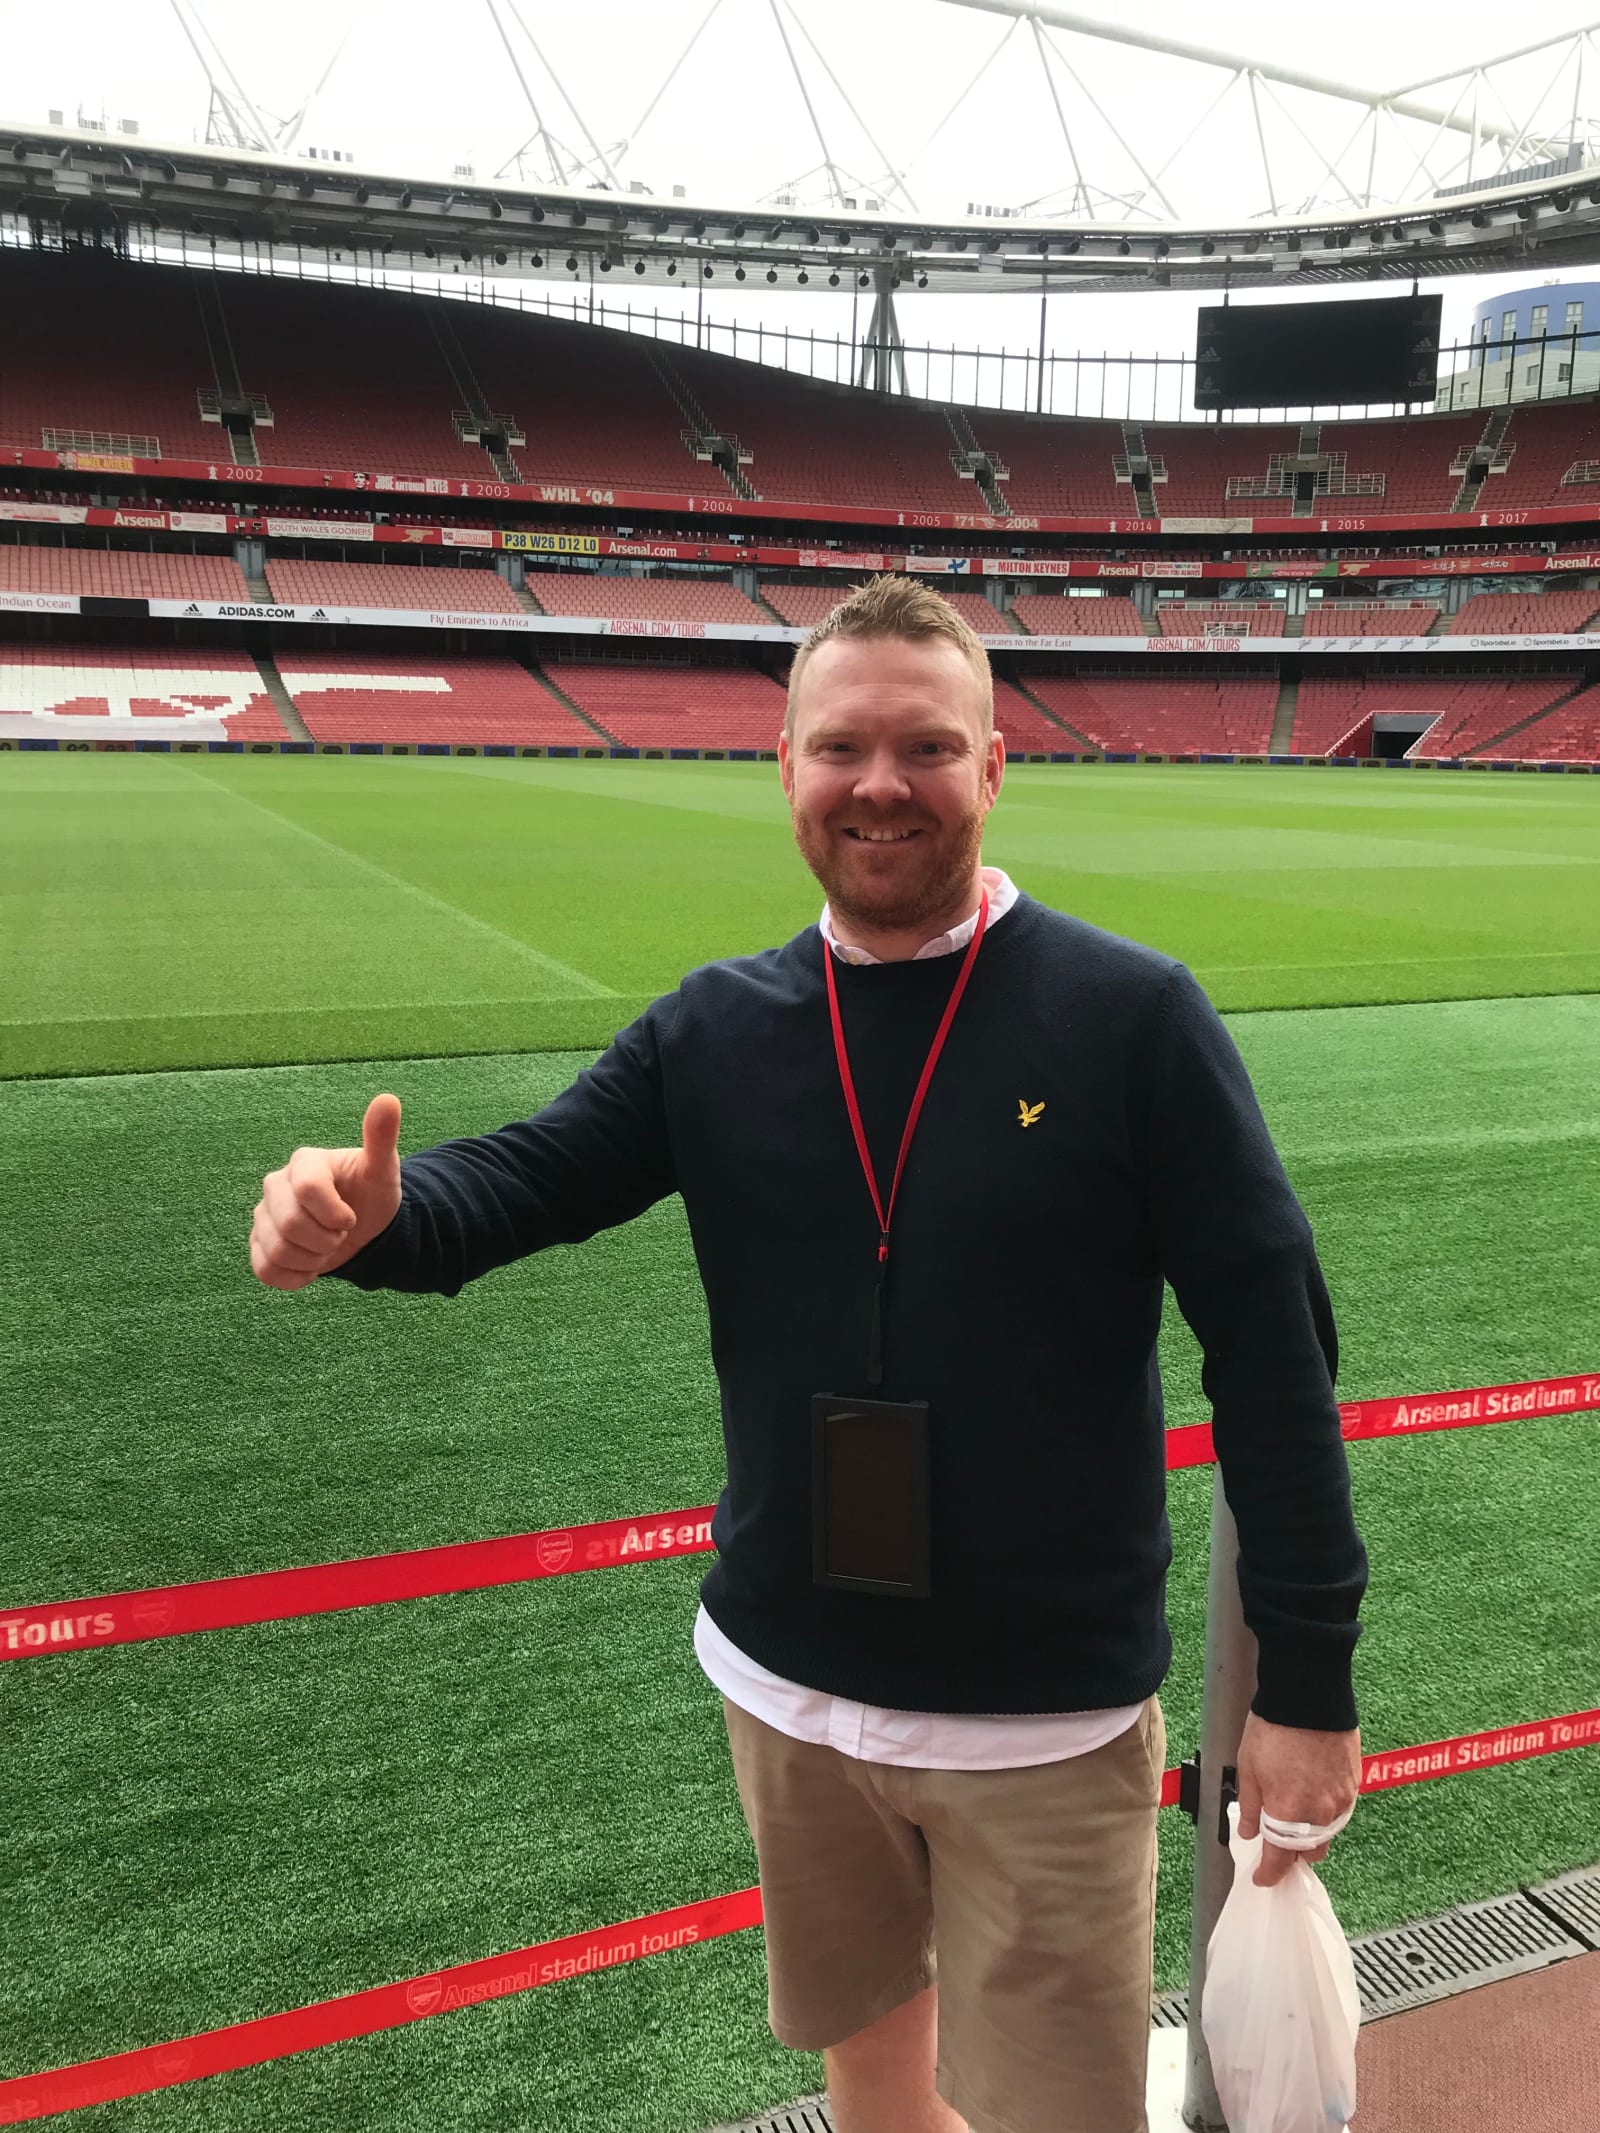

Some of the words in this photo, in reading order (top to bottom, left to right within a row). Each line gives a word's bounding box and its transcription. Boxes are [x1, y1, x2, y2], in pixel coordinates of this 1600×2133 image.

[226, 467, 263, 481] 2002
[375, 474, 394, 490] JOSE
[425, 478, 449, 494] REYES
[476, 484, 511, 498] 2003
[540, 487, 580, 503] WHL
[702, 500, 733, 513] 2004
[113, 511, 166, 529] Arsenal
[912, 514, 941, 527] 2005
[1005, 517, 1039, 529] 2004
[1337, 519, 1365, 530] 2015
[1498, 513, 1528, 525] 2017
[269, 523, 298, 532] SOUTH
[301, 526, 329, 534] WALES
[331, 527, 372, 536] GOONERS
[1125, 521, 1152, 532] 2014
[504, 534, 527, 548] P38
[530, 535, 555, 549] W26
[558, 537, 580, 551] D12
[608, 541, 677, 558] Arsenal.com
[998, 561, 1031, 574] MILTON
[1033, 562, 1068, 575] KEYNES
[1097, 564, 1139, 576] Arsenal
[36, 597, 71, 609] Ocean
[218, 606, 295, 619] ADIDAS.COM
[430, 614, 444, 625] Fly
[447, 614, 486, 626] Emirates
[489, 616, 498, 627] to
[500, 617, 529, 628] Africa
[610, 620, 705, 638] ARSENAL.COM/TOURS
[1015, 638, 1023, 647] to
[1025, 638, 1039, 648] the
[1040, 638, 1052, 648] Far
[1055, 639, 1072, 648] East
[1147, 638, 1240, 652] ARSENAL.COM/TOURS
[1480, 639, 1517, 648] Sportsbet.io
[1392, 1394, 1481, 1428] Arsenal
[1486, 1385, 1577, 1416] Stadium
[542, 1538, 568, 1549] Arsenal
[620, 1521, 713, 1556] Arsen
[0, 1612, 116, 1649] Tours
[1366, 1746, 1450, 1785] Arsenal
[1457, 1731, 1544, 1766] Stadium
[1550, 1720, 1600, 1745] Tours
[441, 1963, 538, 2011] Arsenal
[541, 1942, 636, 1983] stadium
[641, 1924, 699, 1954] tours
